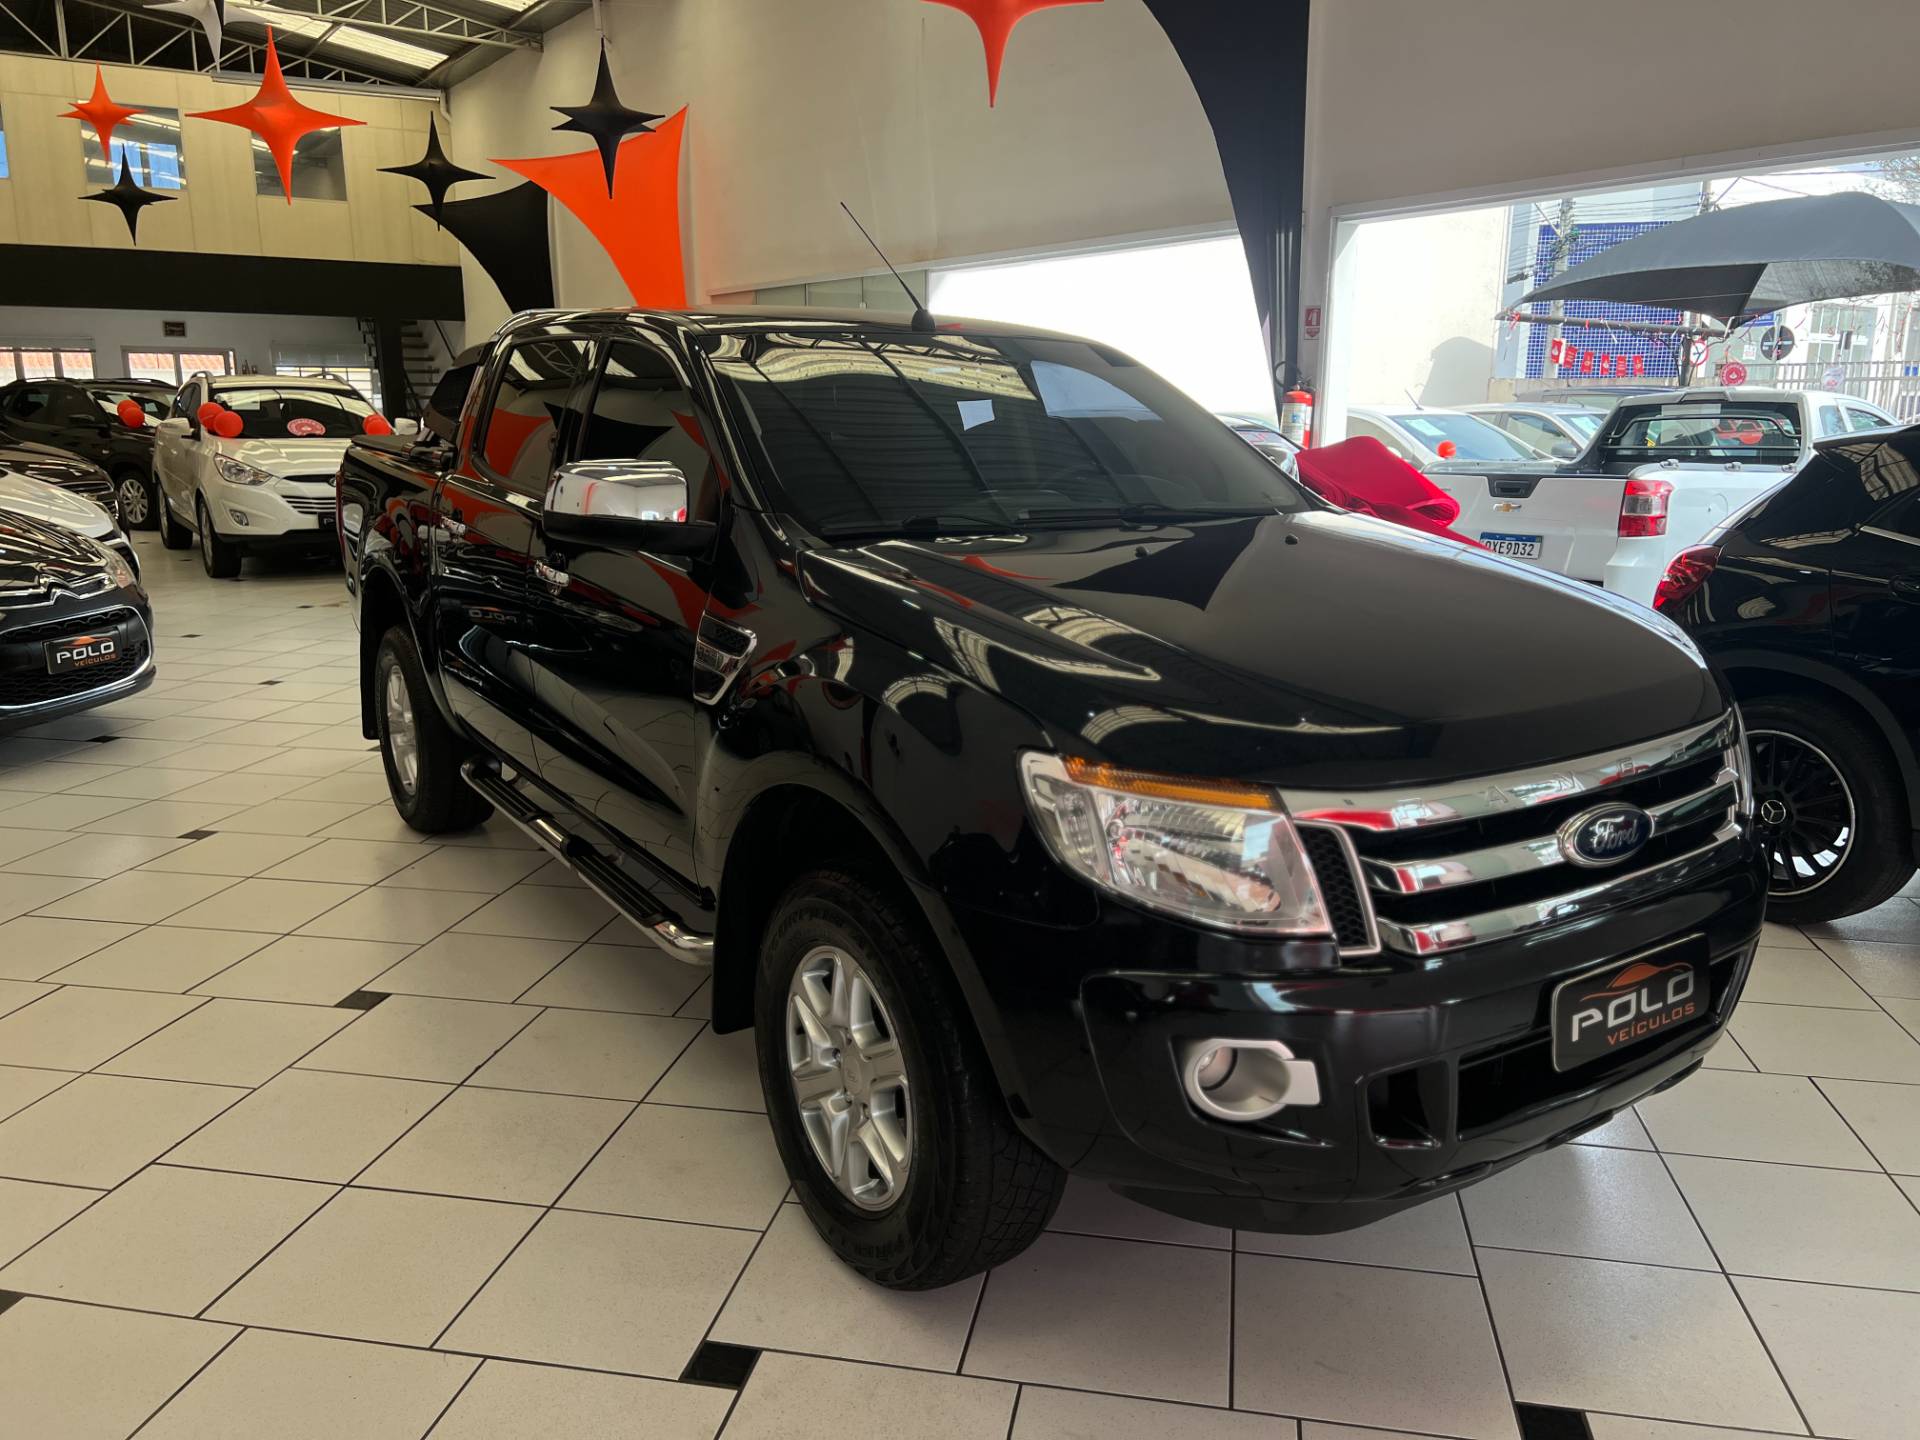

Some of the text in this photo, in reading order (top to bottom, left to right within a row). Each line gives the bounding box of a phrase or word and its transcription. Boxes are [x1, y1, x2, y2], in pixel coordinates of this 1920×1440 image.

[56, 641, 115, 664] POLO
[1589, 815, 1639, 850] Ford
[1571, 970, 1694, 1043] POLO
[1607, 1002, 1696, 1045] VEÍCULOS
